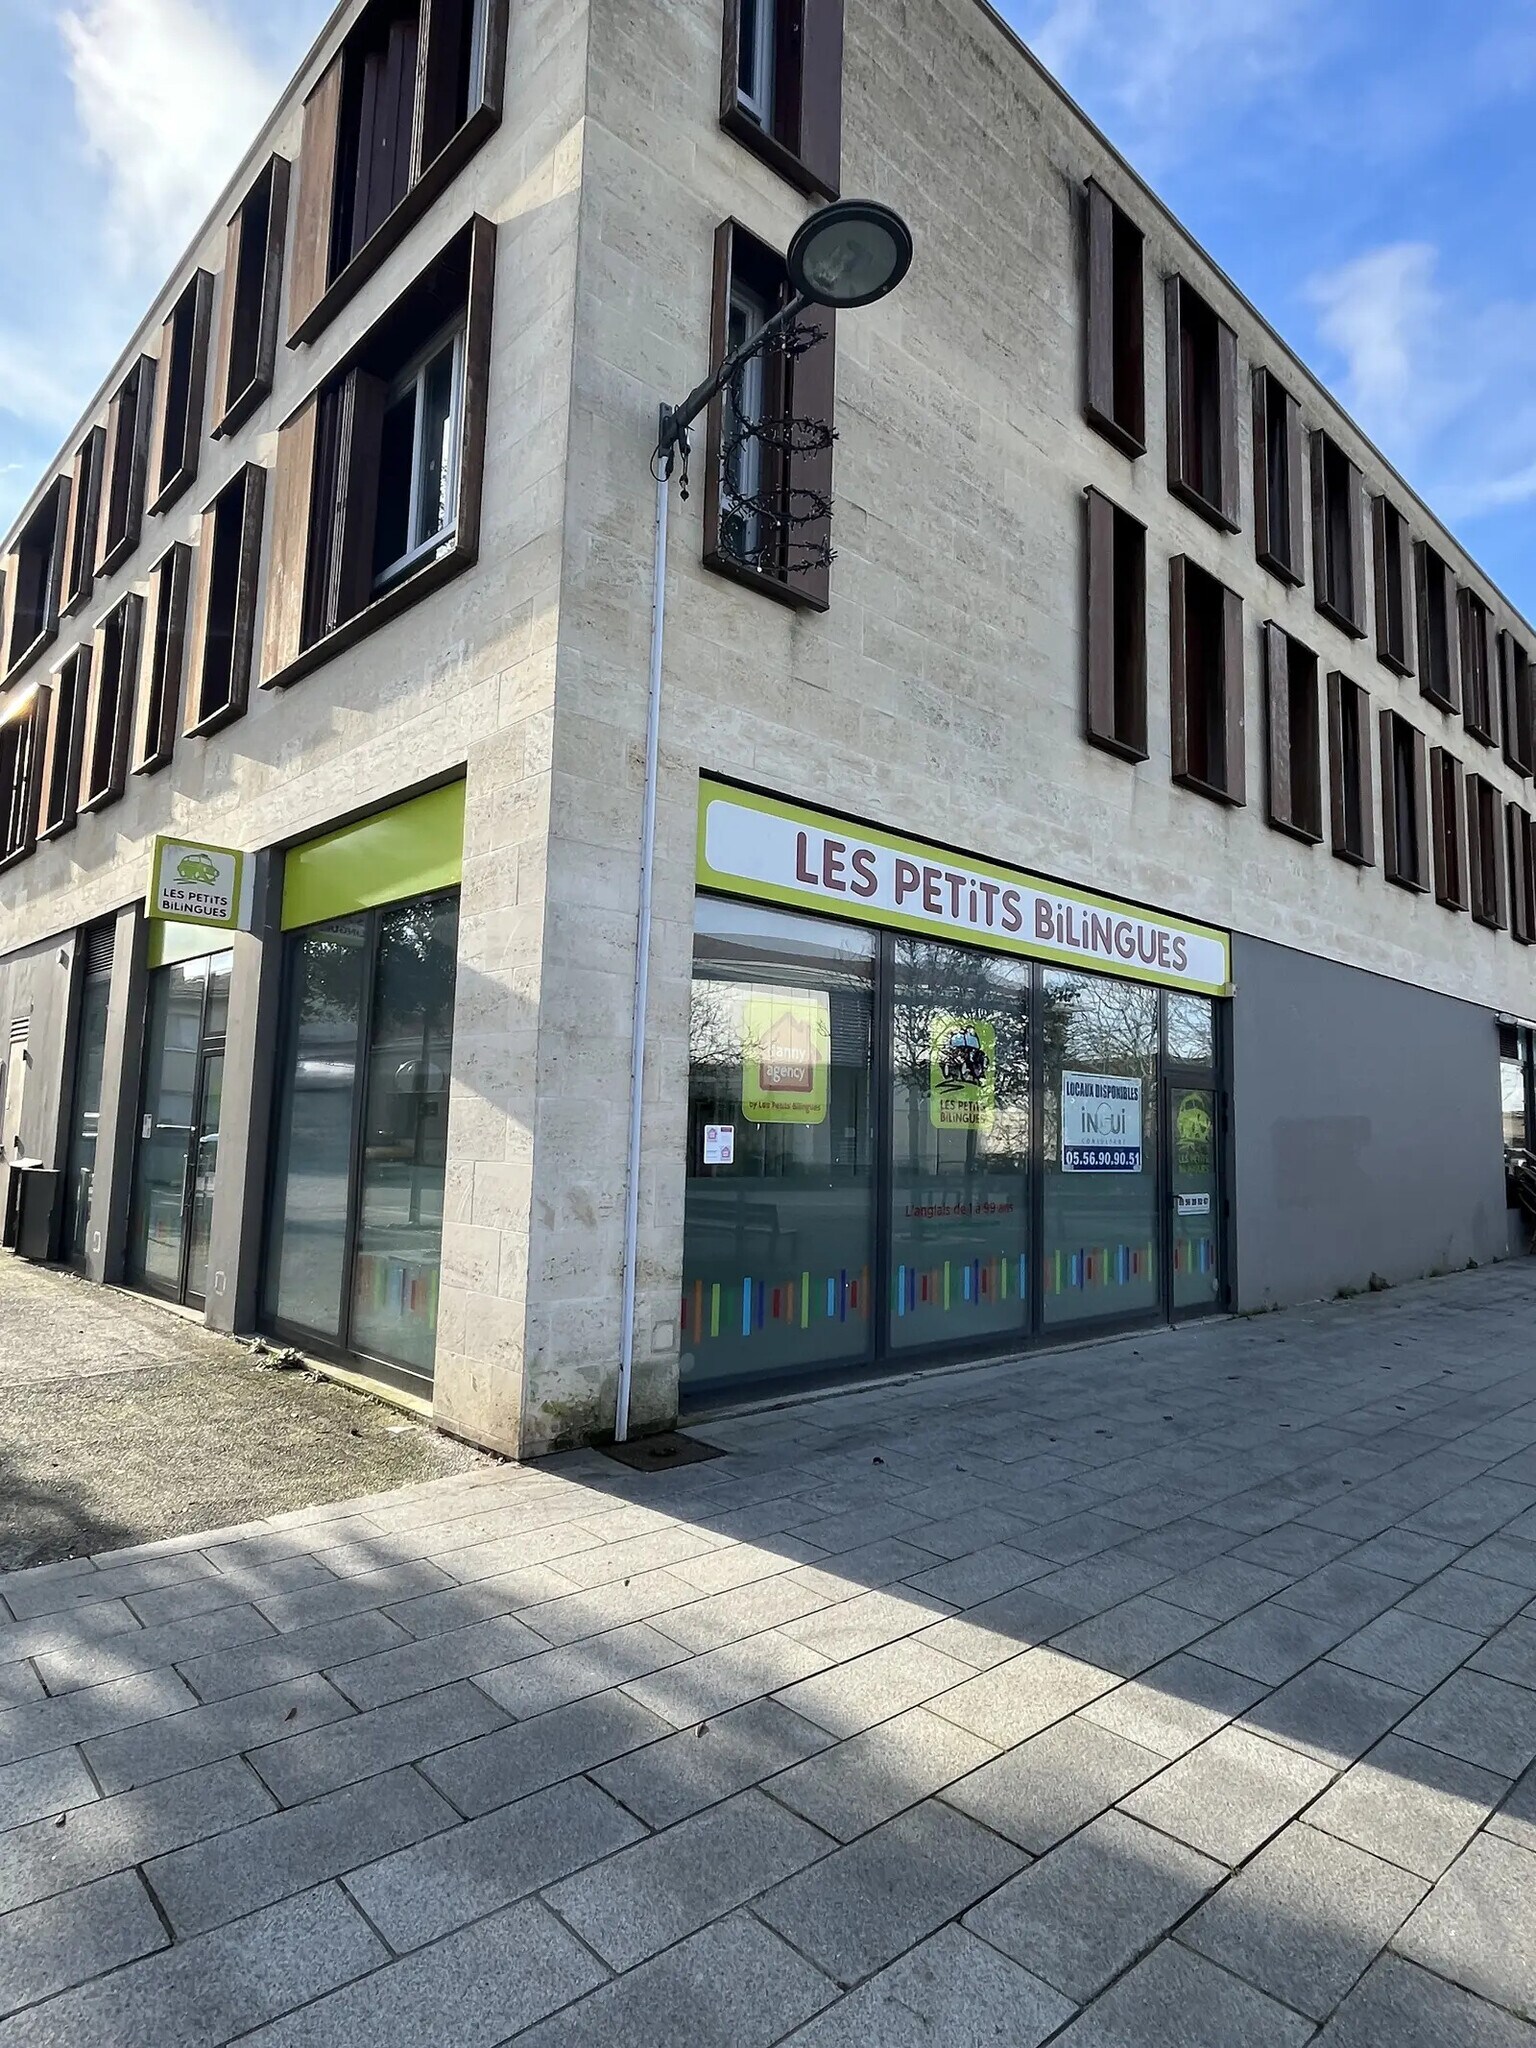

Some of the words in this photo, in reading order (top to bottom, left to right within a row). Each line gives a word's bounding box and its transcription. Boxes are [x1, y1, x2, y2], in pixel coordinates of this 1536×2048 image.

[795, 830, 879, 898] LES
[163, 888, 185, 900] LES
[766, 1065, 805, 1083] agency
[1066, 1081, 1094, 1098] LOCAUX
[1095, 1084, 1139, 1101] DISPONIBLES
[940, 1099, 956, 1111] LES
[1065, 1151, 1140, 1166] 05.56.90.90.51
